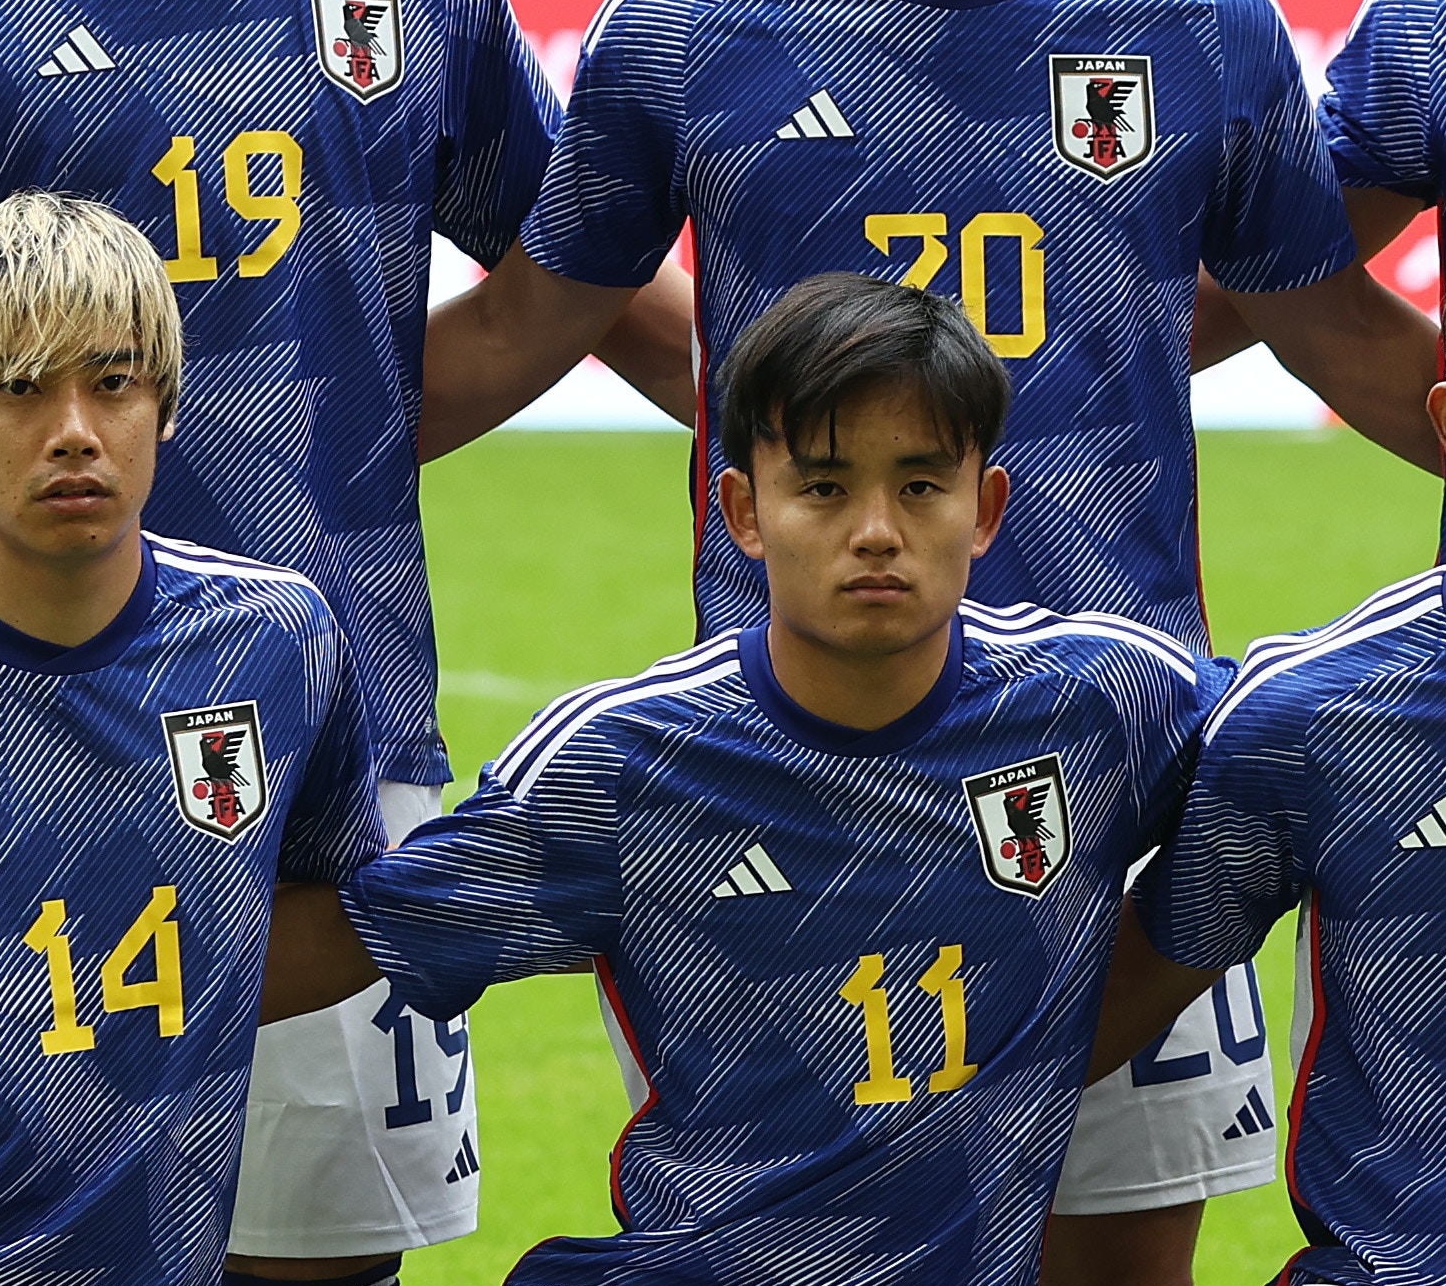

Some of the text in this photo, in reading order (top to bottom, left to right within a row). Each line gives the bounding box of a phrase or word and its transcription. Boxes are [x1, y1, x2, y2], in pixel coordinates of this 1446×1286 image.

[344, 58, 381, 82] JFA
[1075, 60, 1126, 72] JAPAN
[1083, 139, 1127, 160] JFA
[151, 130, 303, 283] 19
[864, 212, 1047, 359] 20
[186, 710, 234, 727] JAPAN
[989, 765, 1037, 788] JAPAN
[207, 796, 246, 821] JFA
[1015, 851, 1051, 879] JFA
[22, 885, 185, 1056] 14
[838, 944, 978, 1106] 11
